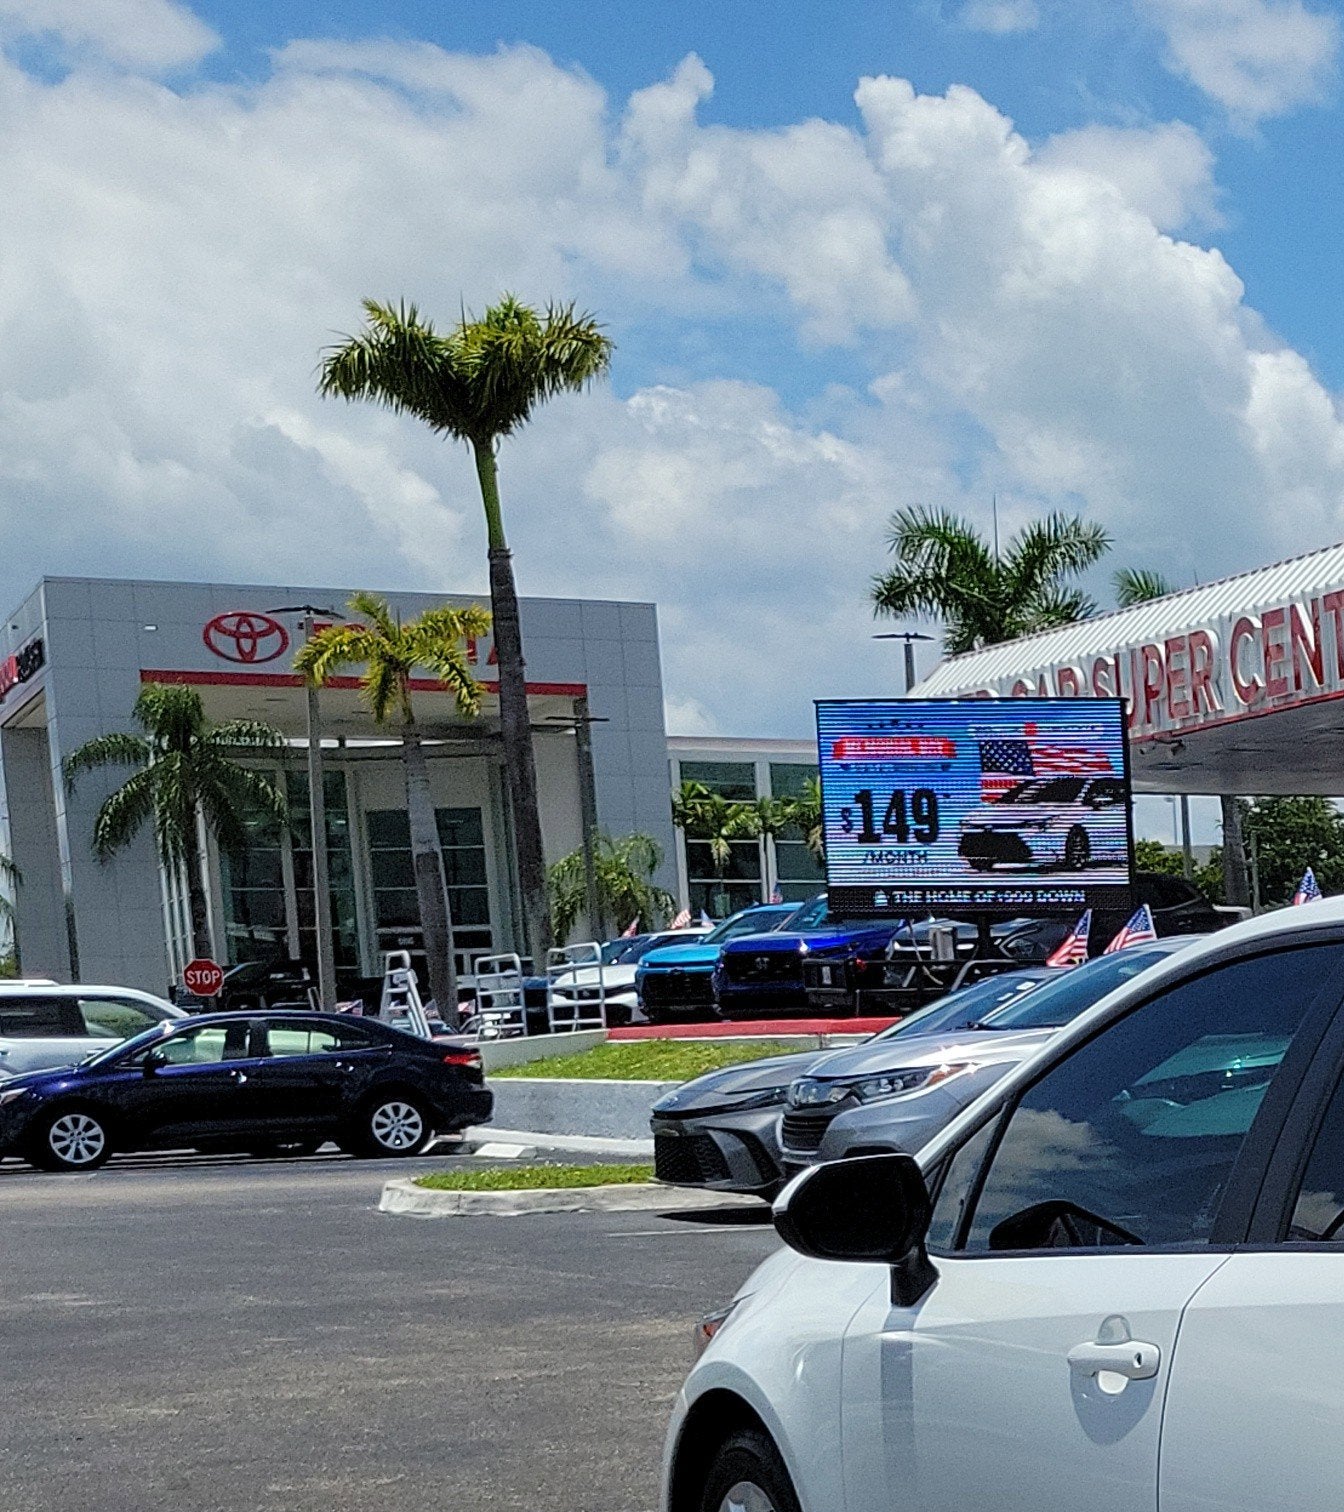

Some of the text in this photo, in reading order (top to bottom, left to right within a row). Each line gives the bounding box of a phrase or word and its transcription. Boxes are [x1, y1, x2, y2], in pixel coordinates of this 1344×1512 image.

[1093, 630, 1220, 728] SUPER
[892, 890, 922, 903] THE
[926, 890, 971, 903] HOME
[974, 890, 996, 903] OF
[1036, 890, 1085, 903] DOWN
[186, 970, 220, 985] STOP
